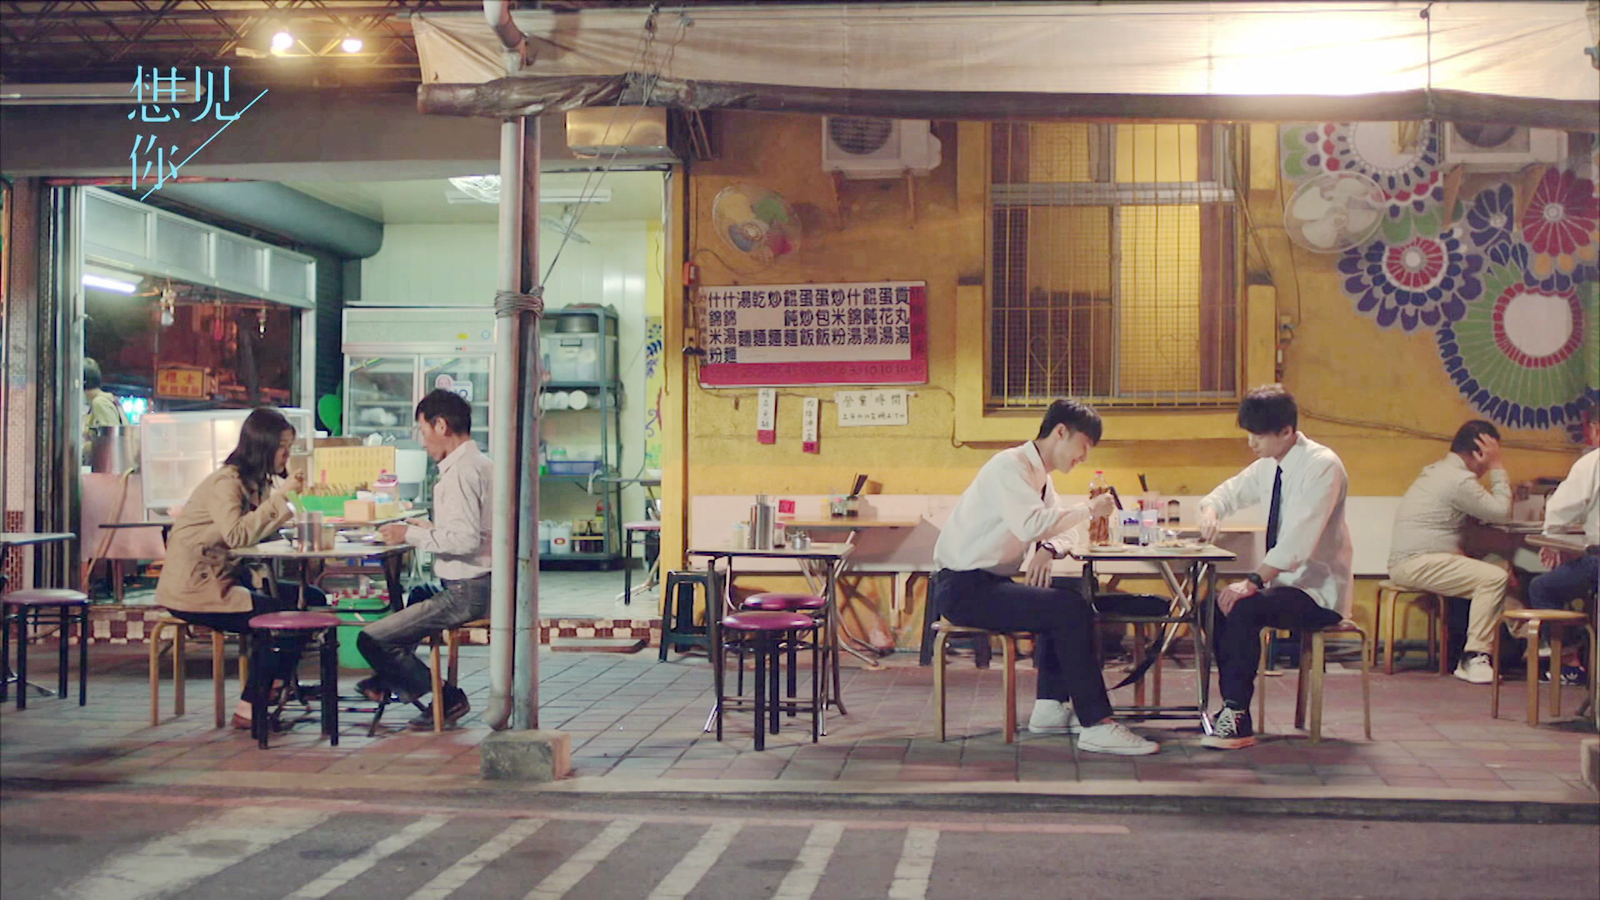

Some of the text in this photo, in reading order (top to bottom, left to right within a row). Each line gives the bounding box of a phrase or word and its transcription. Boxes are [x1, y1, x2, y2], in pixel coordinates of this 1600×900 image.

[708, 291, 723, 364] 什錦米粉
[723, 291, 737, 364] 什錦湯麵
[737, 291, 752, 348] 湯麵
[752, 291, 766, 347] 乾麵
[768, 291, 782, 347] 炒麵
[783, 289, 799, 347] 餛飩麵
[799, 289, 815, 347] 蛋炒飯
[815, 289, 831, 346] 蛋包飯
[831, 290, 846, 345] 炒米粉
[847, 288, 862, 345] 什錦湯
[863, 288, 878, 345] 餛飩湯
[879, 287, 894, 345] 蛋花湯
[894, 286, 911, 345] 貢丸湯
